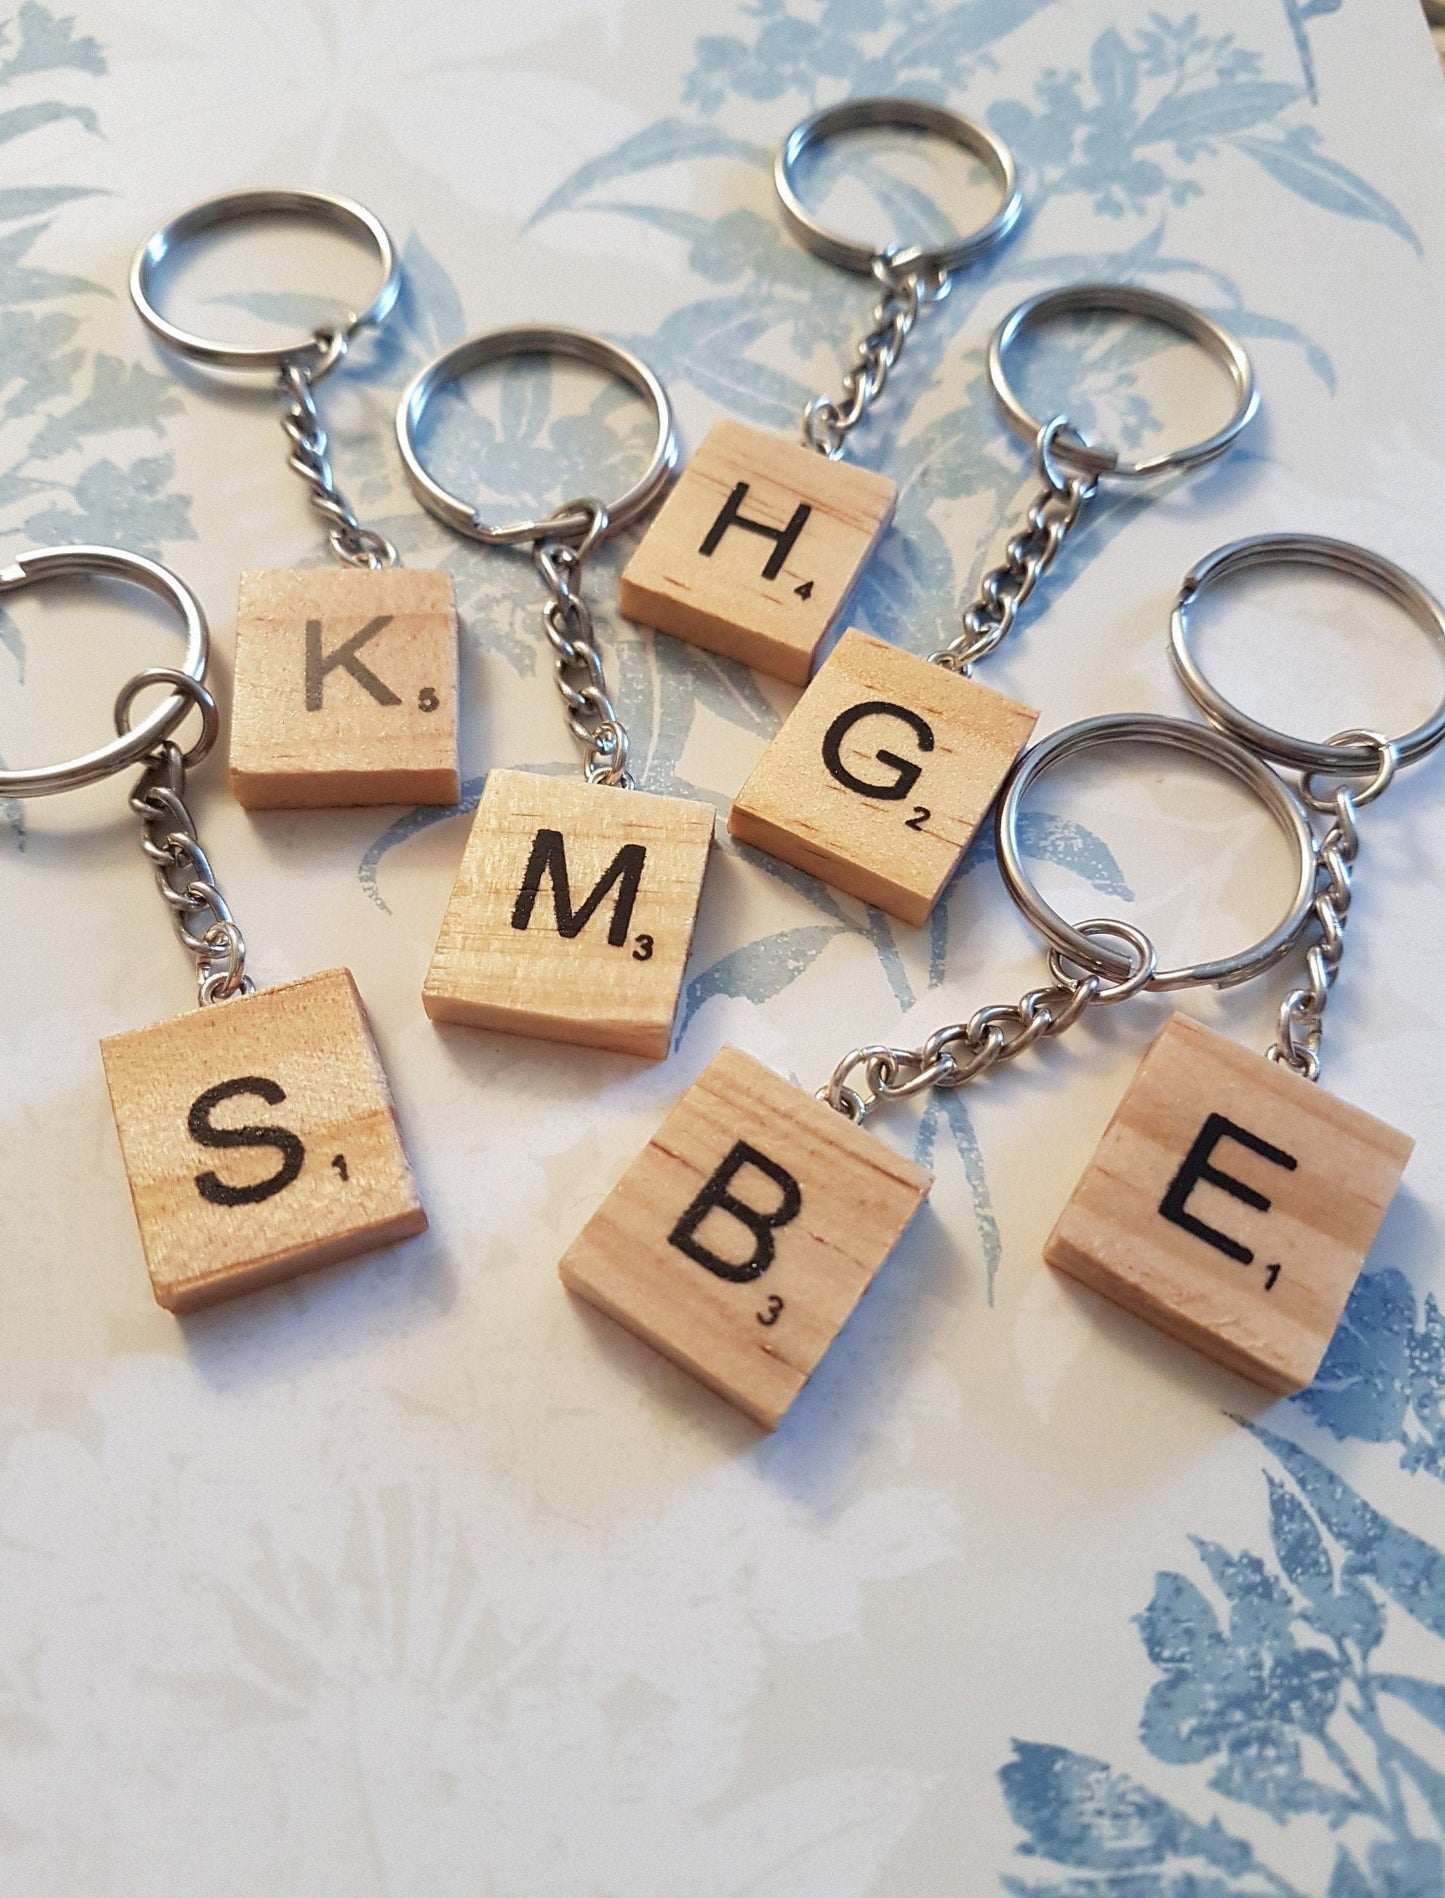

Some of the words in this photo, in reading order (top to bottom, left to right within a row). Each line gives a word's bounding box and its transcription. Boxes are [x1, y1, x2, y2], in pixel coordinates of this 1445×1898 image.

[699, 482, 812, 580] H
[794, 580, 815, 602] 4
[305, 613, 403, 712] K
[417, 687, 440, 714] 5
[822, 701, 936, 802] G
[905, 807, 932, 832] 2
[511, 829, 647, 948] M
[631, 934, 655, 962] 3
[188, 1076, 307, 1209] S
[331, 1154, 350, 1182] 1
[1158, 1113, 1298, 1266] E
[1264, 1264, 1282, 1292] 1
[667, 1139, 803, 1285] B
[756, 1295, 786, 1328] 3
